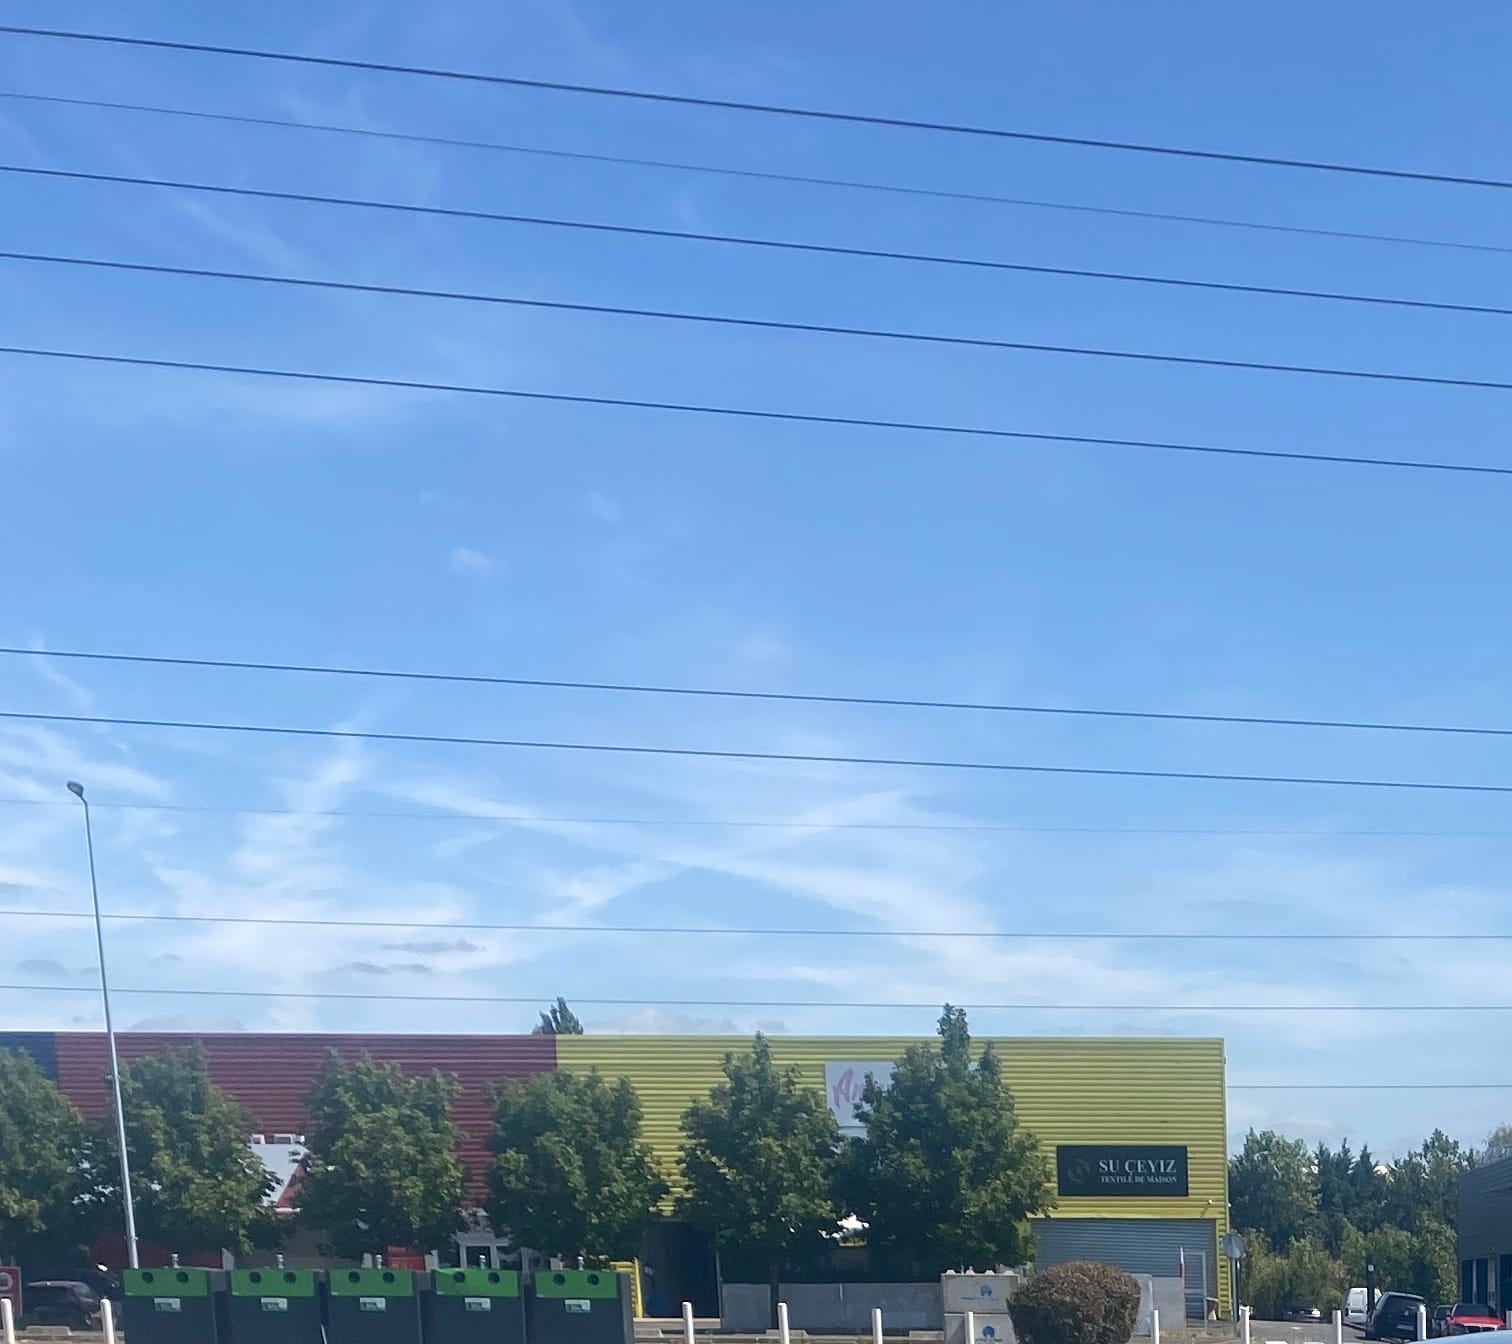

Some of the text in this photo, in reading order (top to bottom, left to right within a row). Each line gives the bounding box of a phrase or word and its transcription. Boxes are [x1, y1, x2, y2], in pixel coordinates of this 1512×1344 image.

[1099, 1159, 1177, 1176] SU ÇEYIZ
[1100, 1175, 1177, 1183] TEXTILE DE MAISON
